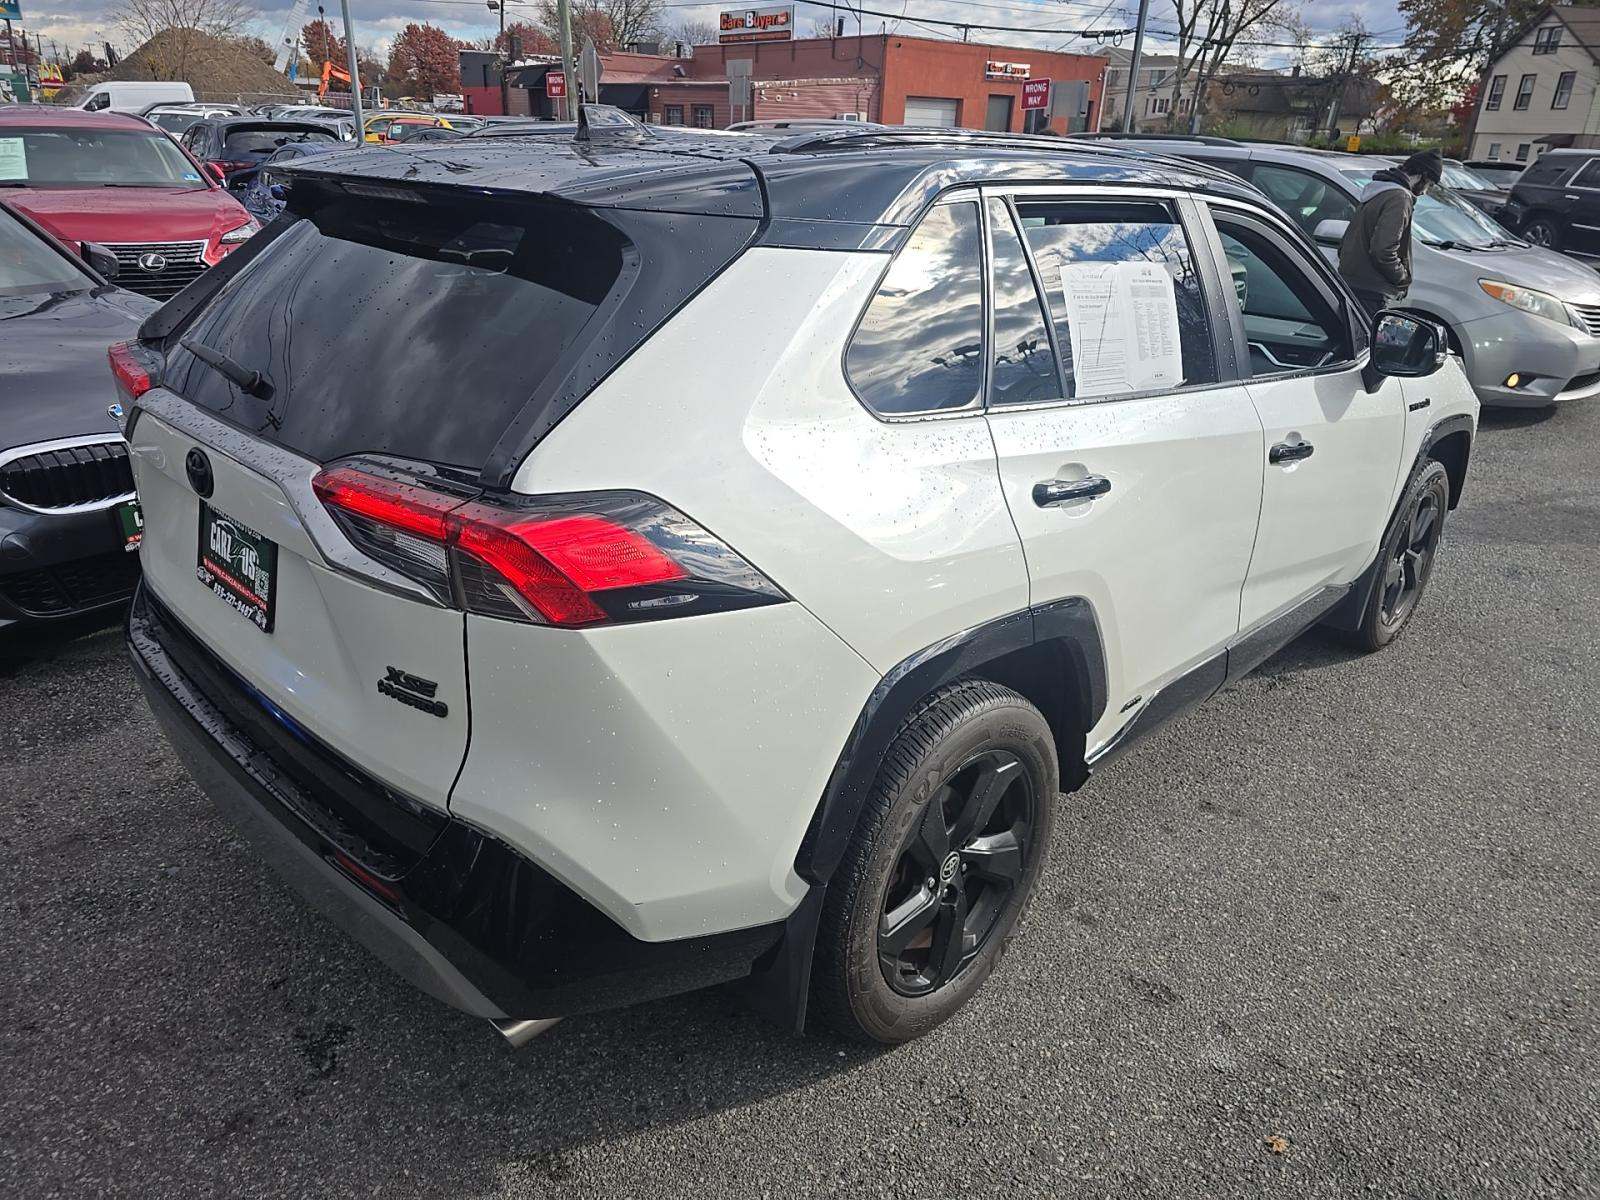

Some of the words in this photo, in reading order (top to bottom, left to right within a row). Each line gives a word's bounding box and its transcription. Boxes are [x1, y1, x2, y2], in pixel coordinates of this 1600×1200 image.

[720, 13, 744, 30] Cars
[1025, 83, 1047, 94] WRONG
[1028, 95, 1042, 105] WAY
